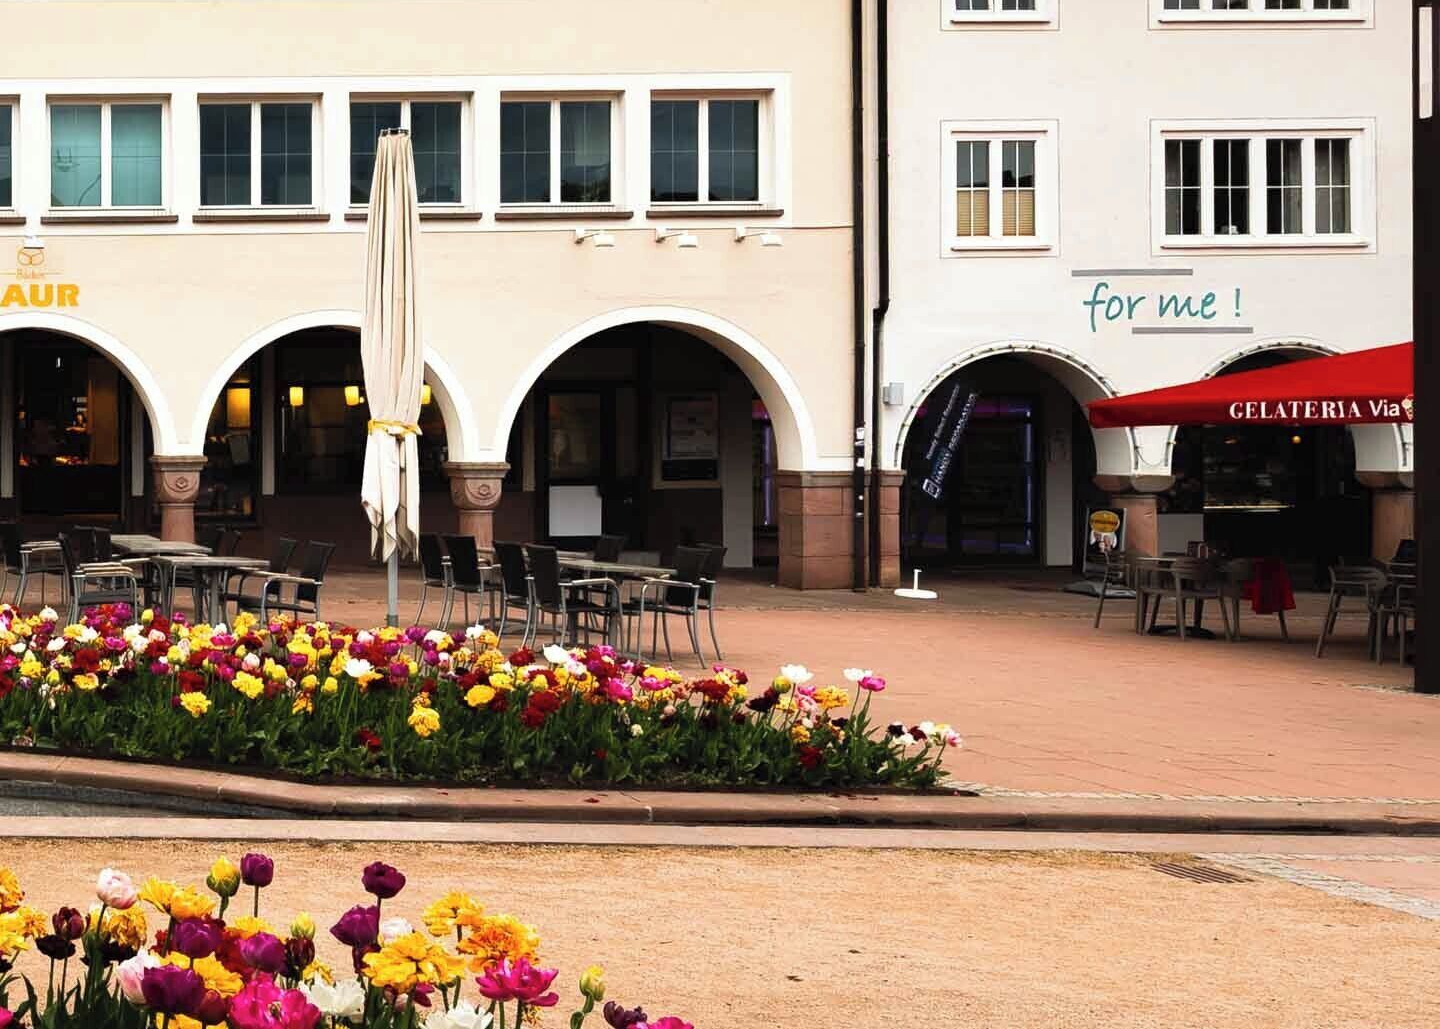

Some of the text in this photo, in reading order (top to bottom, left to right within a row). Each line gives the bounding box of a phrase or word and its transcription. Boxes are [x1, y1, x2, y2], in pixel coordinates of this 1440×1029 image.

[1083, 282, 1147, 333] for
[1158, 291, 1217, 320] me
[1229, 398, 1401, 420] GELATERIA Via
